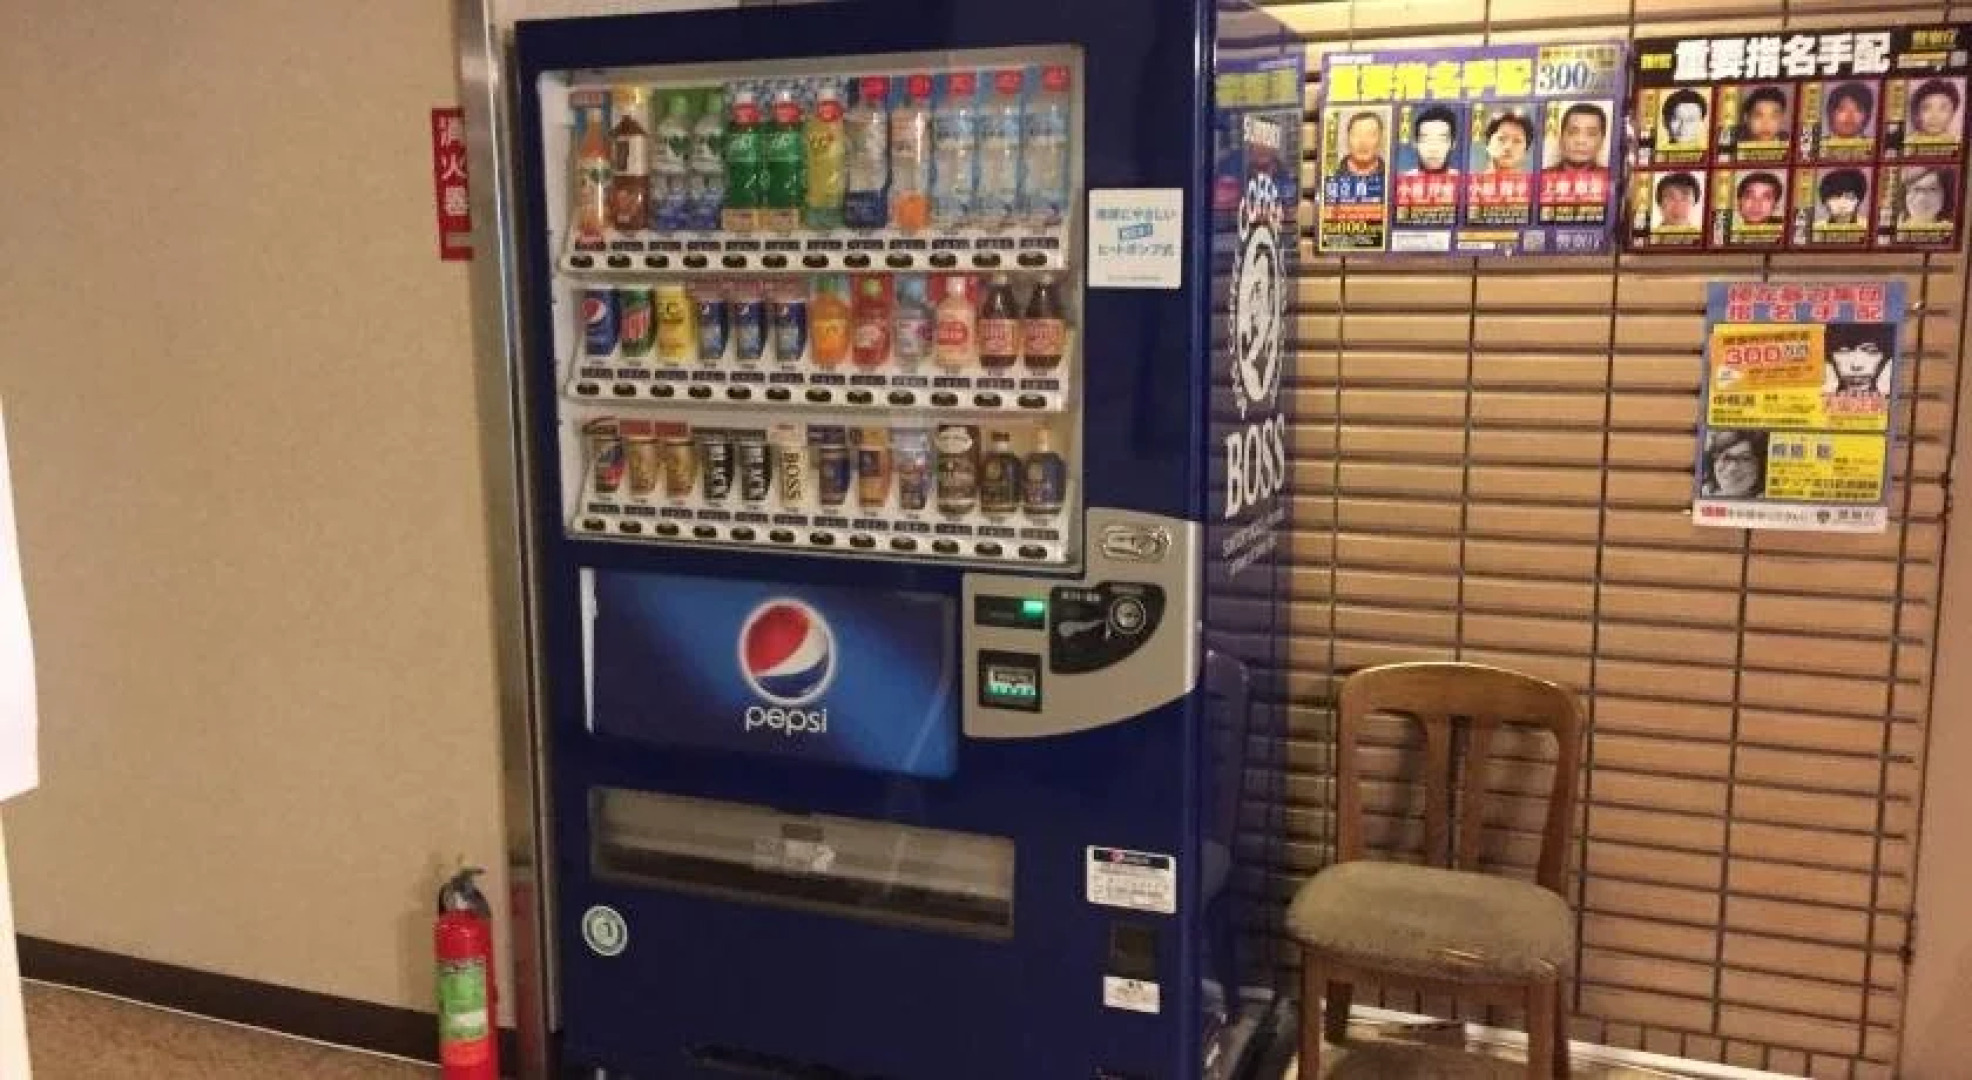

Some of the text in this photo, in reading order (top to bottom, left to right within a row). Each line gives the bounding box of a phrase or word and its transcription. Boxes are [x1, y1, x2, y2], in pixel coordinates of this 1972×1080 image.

[1674, 32, 1891, 80] 重要指名手配
[438, 116, 468, 216] 消火器
[782, 452, 801, 500] BOSS
[1224, 413, 1285, 519] BOSS
[745, 706, 827, 735] pepsi
